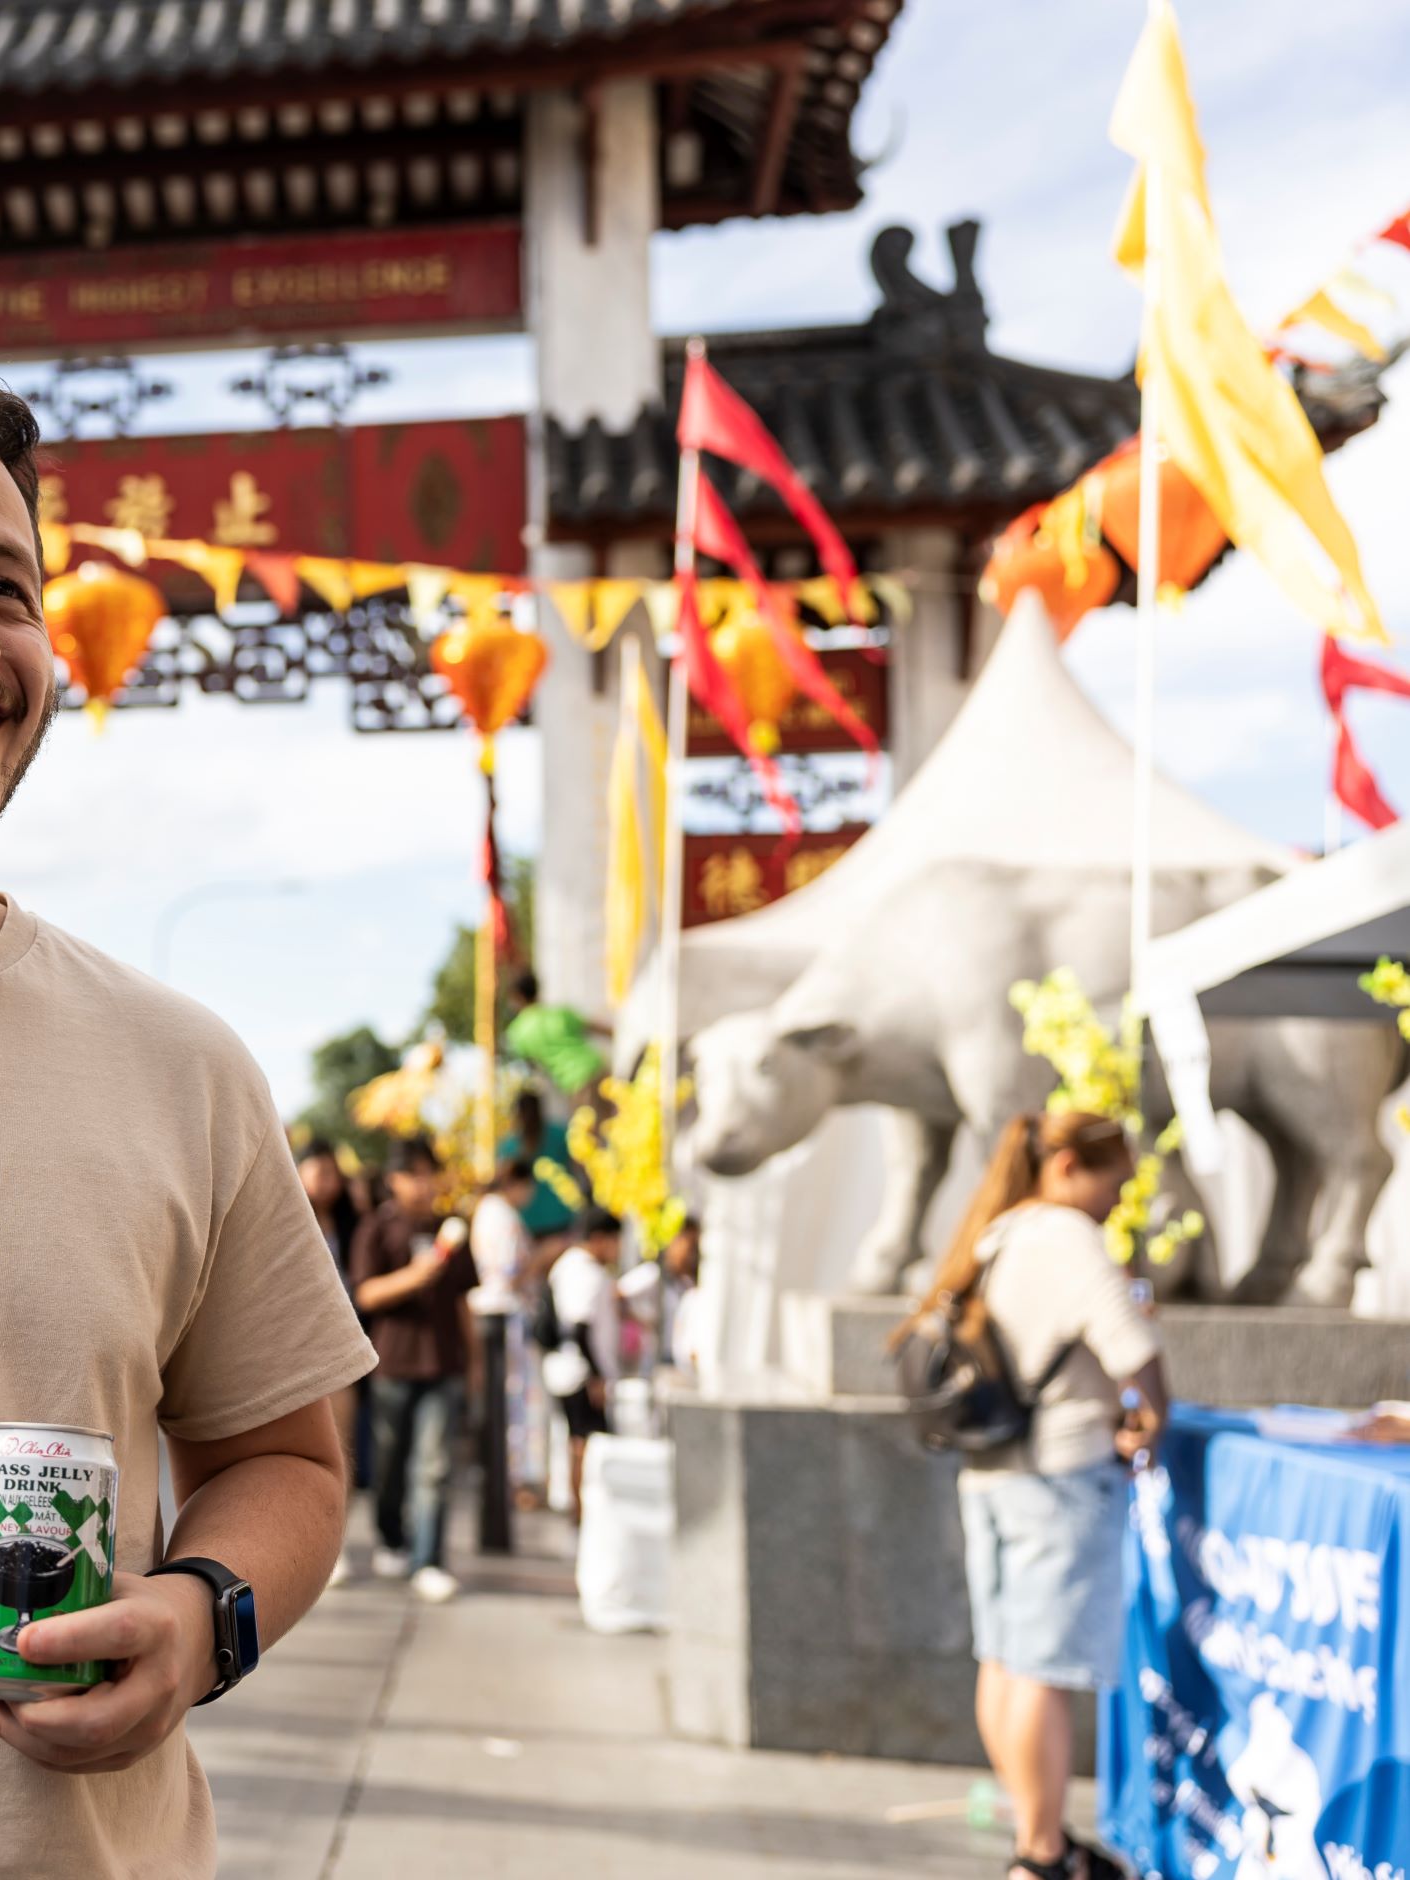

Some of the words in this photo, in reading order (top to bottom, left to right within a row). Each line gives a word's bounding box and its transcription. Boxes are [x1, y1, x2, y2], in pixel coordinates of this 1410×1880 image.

[69, 271, 209, 313] HIGHEST
[230, 254, 452, 308] EXCELLENCE
[38, 1465, 94, 1481] JELLY
[4, 1478, 62, 1493] DRINK
[23, 1524, 74, 1537] FLAVOUR
